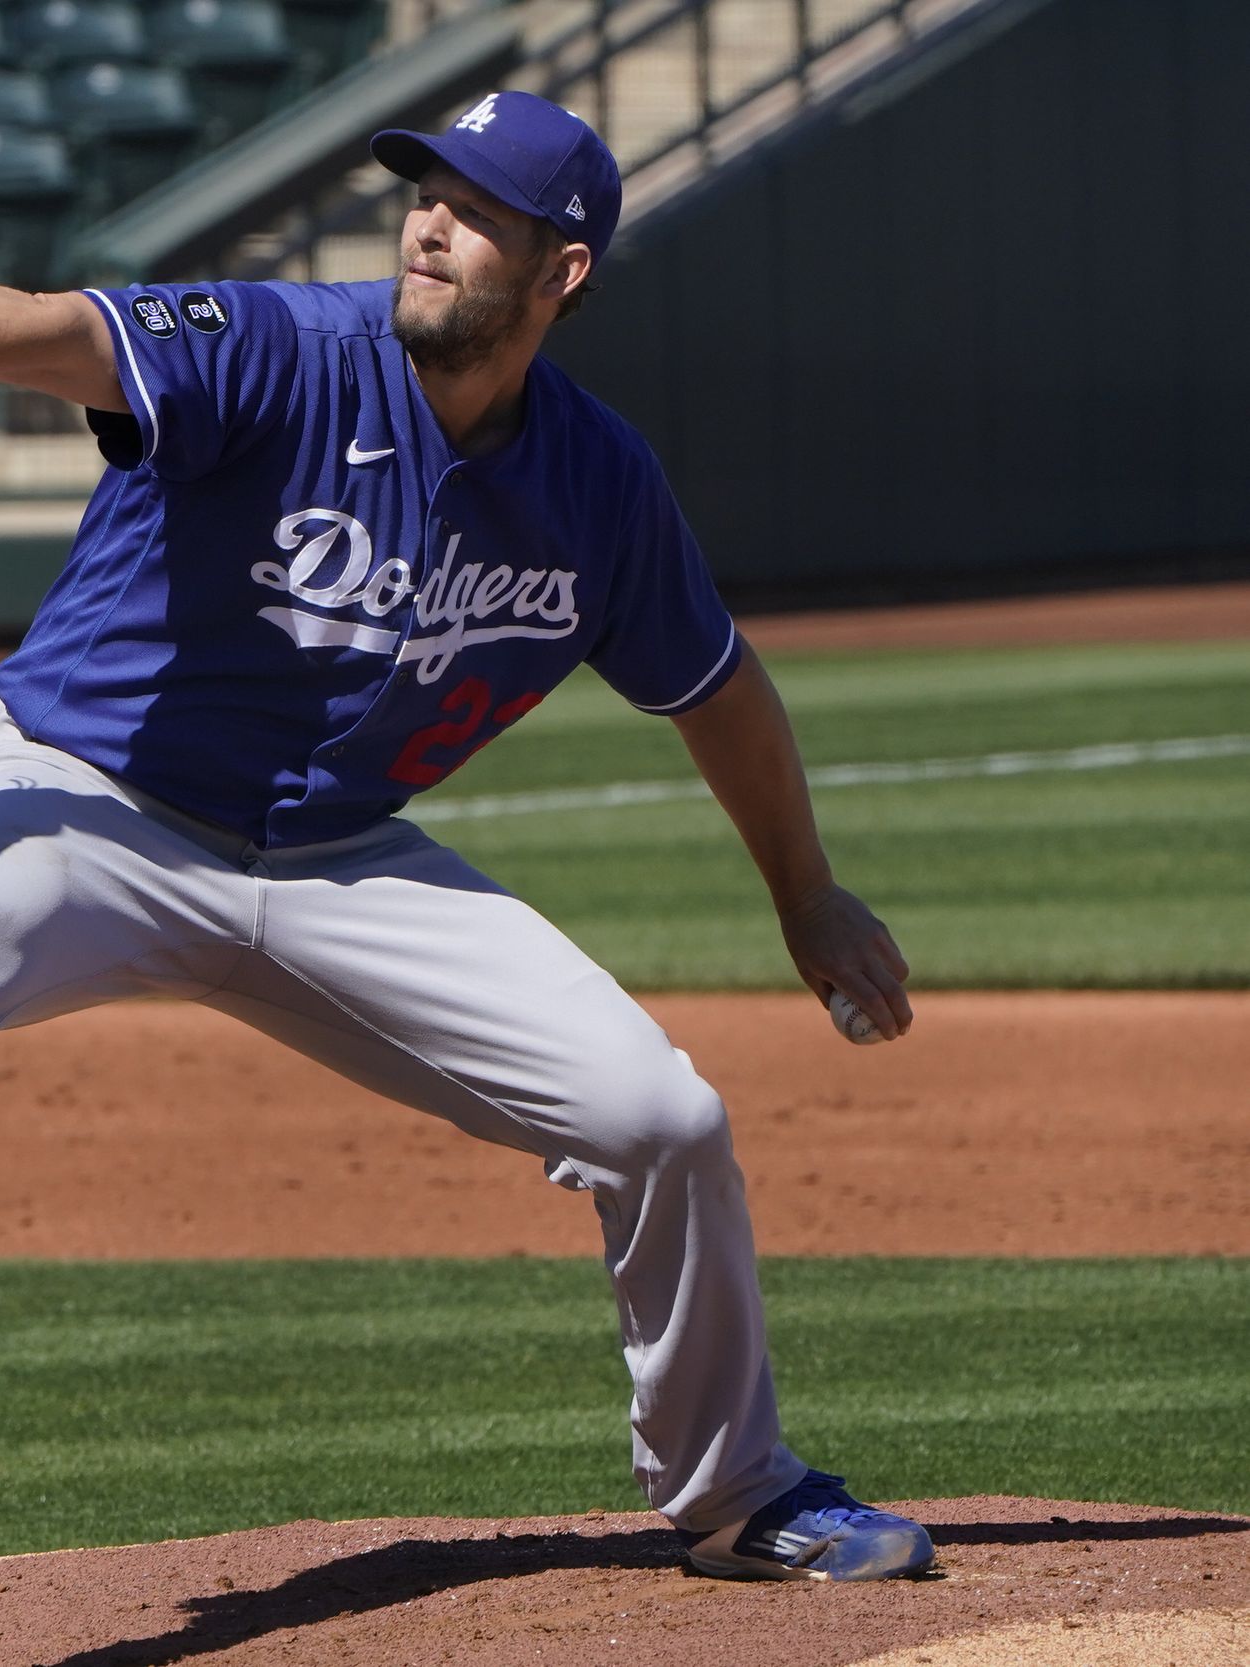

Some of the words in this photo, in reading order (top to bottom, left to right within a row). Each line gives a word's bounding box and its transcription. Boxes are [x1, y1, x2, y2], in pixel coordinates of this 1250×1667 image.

[456, 93, 500, 133] LA
[136, 302, 168, 331] 20
[156, 300, 176, 329] SUTTON
[188, 303, 213, 319] 2
[206, 297, 226, 323] TOMMY
[251, 508, 579, 685] Dodgers
